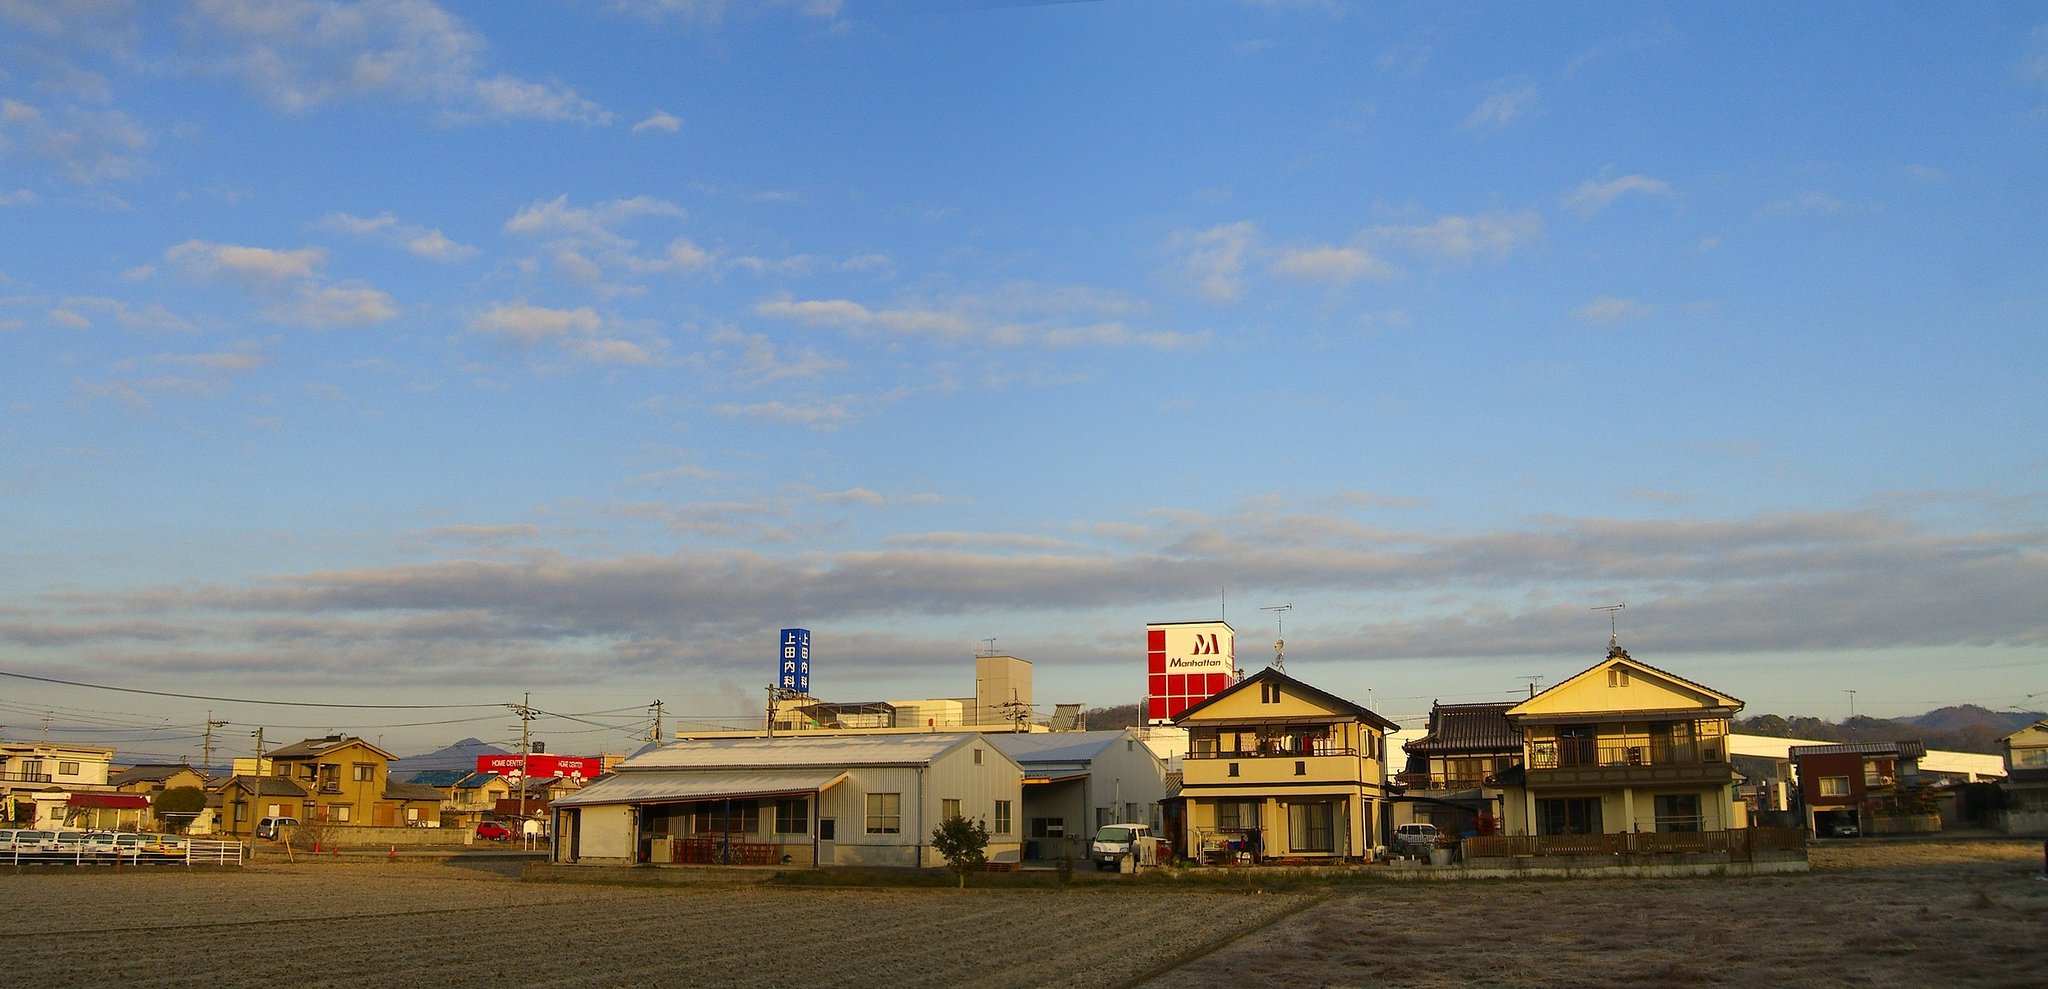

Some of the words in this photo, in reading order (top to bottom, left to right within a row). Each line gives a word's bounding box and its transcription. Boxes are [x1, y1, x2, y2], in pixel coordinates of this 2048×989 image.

[784, 632, 796, 688] 上田内科
[801, 633, 809, 689] 上田内科
[1170, 658, 1221, 667] Manhattan
[491, 759, 505, 767] HOME
[506, 759, 525, 767] CENTE
[558, 760, 569, 768] HOME
[569, 761, 583, 769] CENTER
